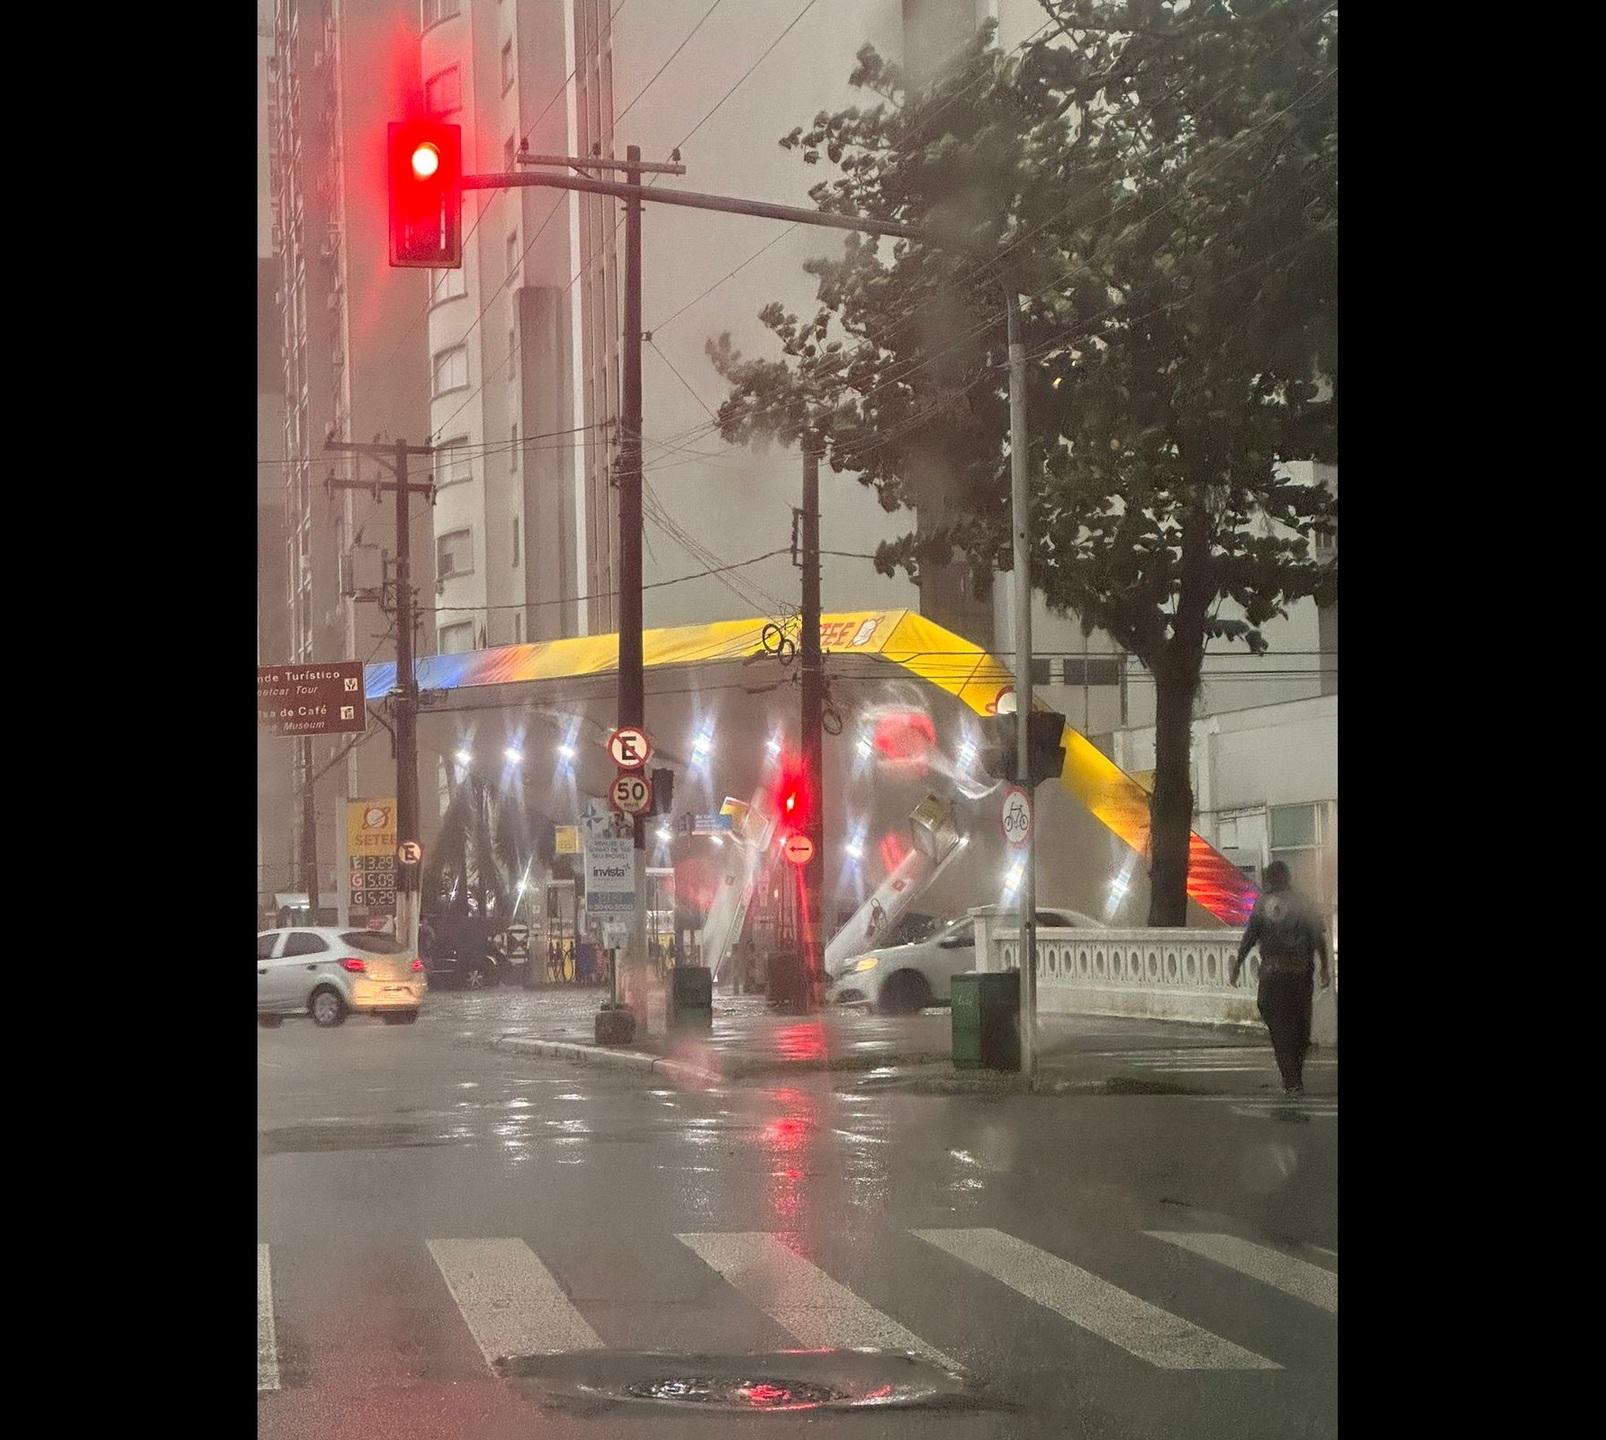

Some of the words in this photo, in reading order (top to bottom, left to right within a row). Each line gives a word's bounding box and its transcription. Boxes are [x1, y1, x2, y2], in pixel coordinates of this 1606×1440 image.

[285, 671, 340, 681] Turístico
[296, 686, 318, 694] Tour
[280, 708, 294, 717] de
[298, 704, 327, 716] Café
[283, 721, 325, 731] Museum
[617, 782, 645, 801] 50
[593, 866, 625, 877] invista
[352, 873, 363, 887] G
[354, 891, 363, 904] G
[368, 891, 395, 905] 5.29
